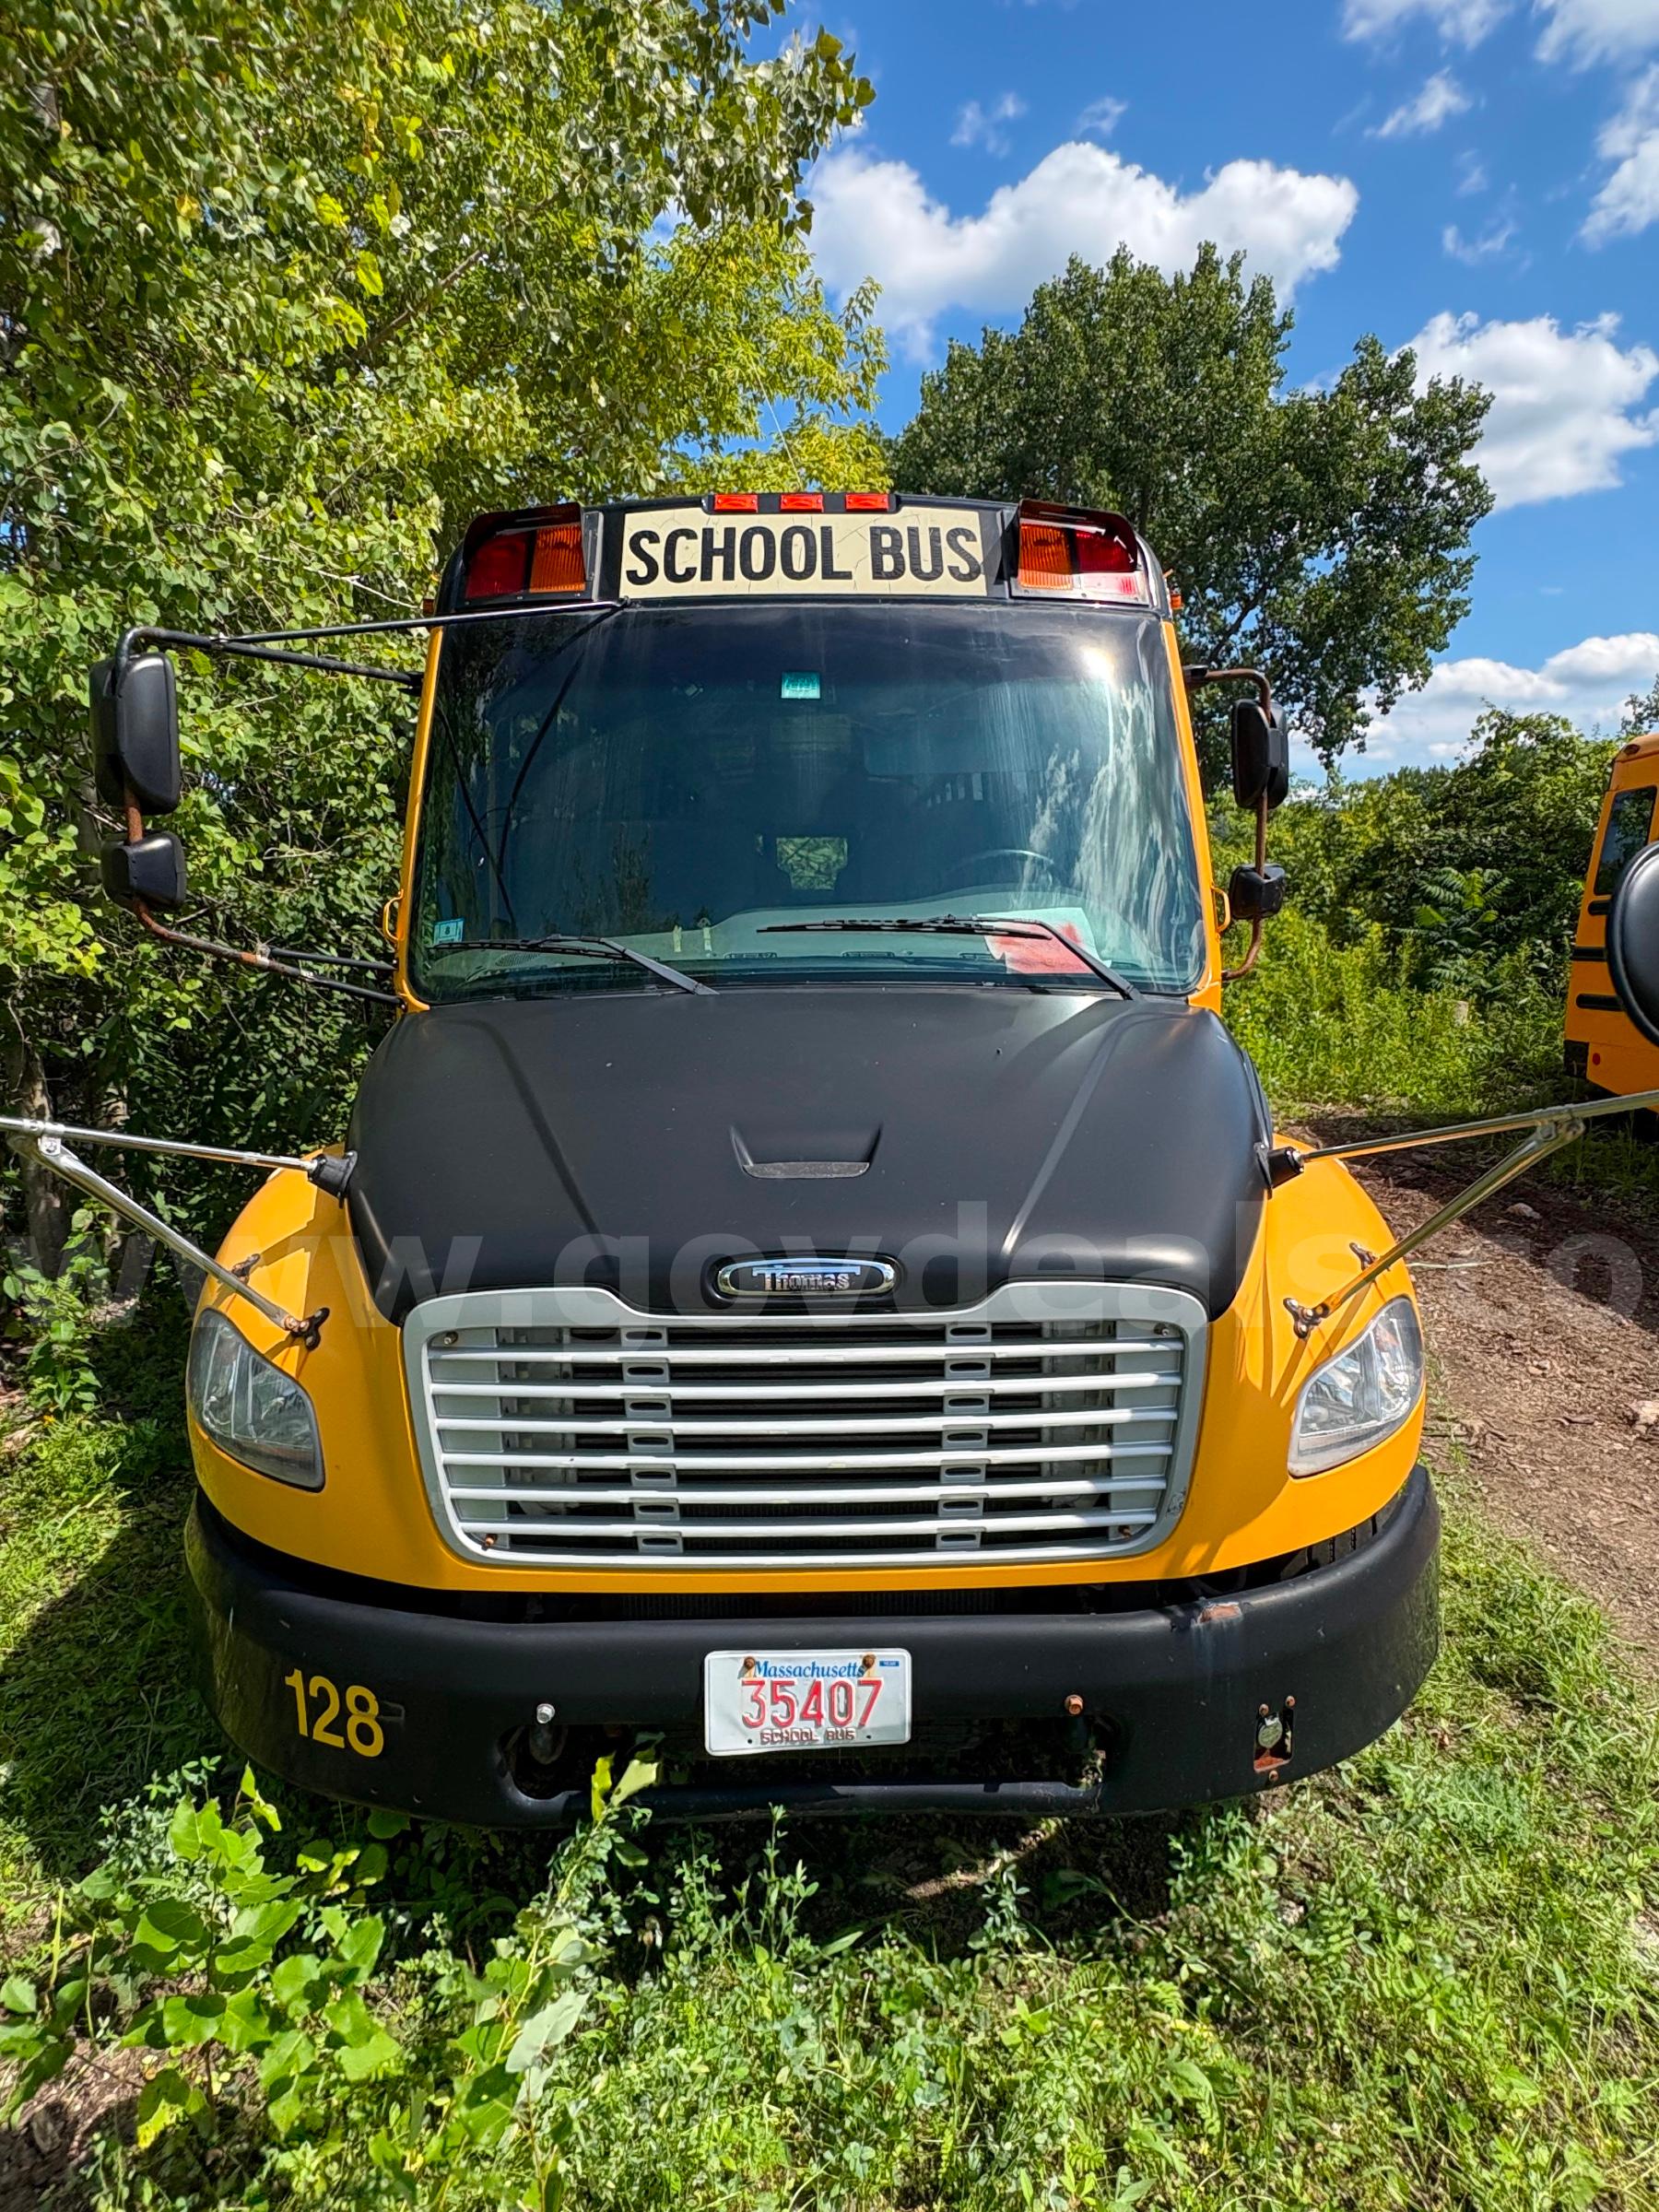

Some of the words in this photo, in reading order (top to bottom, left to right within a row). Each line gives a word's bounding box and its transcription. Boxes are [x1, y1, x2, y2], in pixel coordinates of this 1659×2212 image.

[626, 525, 853, 585] SCHOOL
[869, 526, 982, 582] BUS
[753, 1265, 861, 1290] Thomas
[755, 1661, 866, 1678] Massachusetts
[285, 1668, 383, 1757] 128
[741, 1679, 882, 1729] 35407
[760, 1727, 819, 1745] SCHOOL
[826, 1726, 856, 1740] BUS
